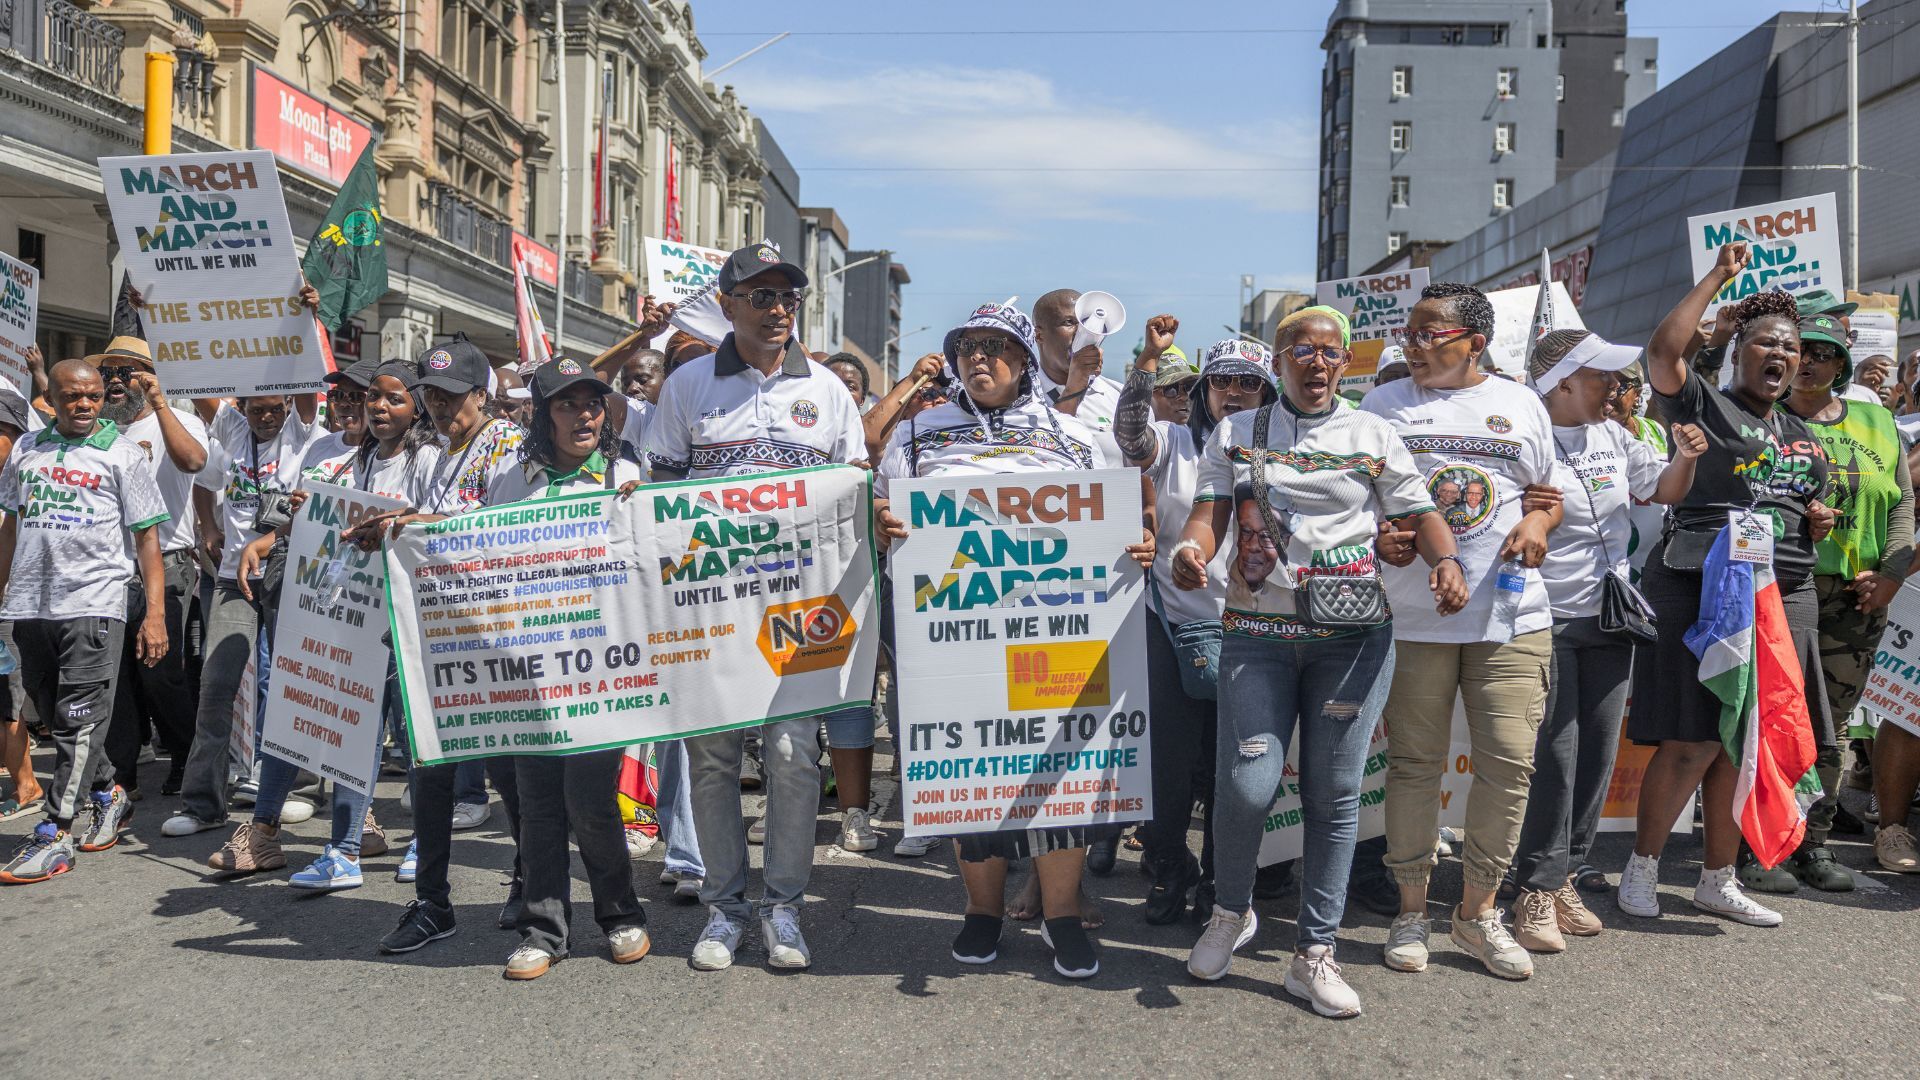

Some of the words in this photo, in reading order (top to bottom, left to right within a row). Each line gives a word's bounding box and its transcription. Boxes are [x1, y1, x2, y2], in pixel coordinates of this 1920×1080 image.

[120, 162, 259, 195] MARCH
[159, 193, 237, 222] AND
[135, 220, 272, 252] MARCH
[1703, 206, 1816, 250] MARCH
[155, 255, 198, 271] UNTIL
[202, 255, 225, 270] WE
[228, 254, 257, 268] WIN
[3, 281, 25, 301] AND
[1336, 274, 1412, 299] MARCH
[144, 302, 191, 324] THE
[198, 297, 302, 321] STREETS
[1352, 293, 1398, 313] AND
[157, 341, 202, 362] ARE
[209, 336, 304, 359] CALLING
[1374, 329, 1388, 339] WE
[797, 416, 813, 425] IFP
[1839, 437, 1885, 473] WESIZWE
[18, 466, 101, 491] MARCH
[28, 485, 78, 503] AND
[653, 480, 808, 523] MARCH
[910, 483, 1105, 529] MARCH
[24, 521, 41, 529] UNTIL
[42, 521, 53, 530] WE
[55, 523, 70, 532] WIN
[424, 501, 602, 535] #DOIT4THEIRFUTURE
[688, 514, 780, 551] AND
[1459, 528, 1484, 542] SERVICE
[1484, 520, 1494, 533] AND
[425, 520, 611, 555] #DOIT4YOURCOUNTRY
[950, 527, 1068, 569] AND
[415, 546, 606, 578] #STOPHOMEAFFAIRSCORRUPTION
[659, 539, 813, 585] MARCH
[1310, 545, 1369, 568] ALUTA
[1734, 553, 1770, 562] OBSERVER
[417, 580, 437, 594] JOIN
[439, 579, 452, 591] US
[455, 578, 465, 589] IN
[468, 573, 513, 588] FIGHTING
[517, 568, 558, 582] ILLEGAL
[562, 561, 626, 577] IMMIGRANTS
[420, 595, 438, 608] AND
[440, 591, 468, 605] THEIR
[472, 588, 509, 602] CRIMES
[513, 573, 628, 597] #ENOUGHISENOUGH
[675, 586, 728, 607] UNTIL
[733, 580, 761, 598] WE
[768, 574, 801, 593] WIN
[914, 565, 1107, 612] MARCH
[328, 604, 344, 622] WE
[345, 609, 366, 628] WIN
[422, 609, 445, 622] STOP
[447, 606, 484, 619] ILLEGAL
[557, 594, 593, 607] START
[425, 624, 452, 638] LEGAL
[455, 621, 515, 635] IMMIGRATION
[522, 608, 601, 628] #ABAHAMBE
[430, 638, 490, 654] SEKWANELE
[494, 631, 564, 649] ABAGODUKE
[570, 625, 607, 640] ABONI
[648, 626, 705, 645] RECLAIM
[710, 623, 735, 637] OUR
[928, 618, 997, 643] UNTIL
[1004, 616, 1039, 639] WE
[1048, 613, 1090, 636] WIN
[1235, 617, 1270, 632] LONG
[1273, 620, 1308, 634] LIVE
[301, 636, 328, 657] AWAY
[329, 643, 353, 666] WITH
[434, 660, 477, 688] IT'S
[484, 653, 545, 683] TIME
[555, 648, 593, 676] TO
[605, 642, 641, 669] GO
[650, 648, 710, 666] COUNTRY
[801, 645, 845, 657] IMMIGRATION
[276, 655, 304, 679] CRIME,
[306, 665, 337, 691] DRUGS,
[339, 677, 375, 703] ILLEGAL
[1013, 650, 1049, 684] NO
[1051, 671, 1087, 684] ILLEGAL
[434, 692, 486, 710] ILLEGAL
[489, 683, 573, 704] IMMIGRATION
[578, 681, 592, 695] IS
[597, 679, 609, 693] A
[613, 672, 659, 691] CRIME
[1035, 682, 1105, 697] IMMIGRATION
[1870, 672, 1888, 688] US
[1888, 682, 1904, 697] IN
[283, 685, 339, 719] IMMIGRATION
[341, 708, 360, 726] AND
[437, 714, 465, 729] LAW
[470, 706, 561, 726] ENFORCEMENT
[566, 702, 600, 718] WHO
[604, 695, 654, 711] TAKES
[659, 692, 671, 705] A
[294, 716, 343, 749] EXTORTION
[441, 737, 480, 752] BRIBE
[485, 734, 496, 747] IS
[501, 733, 510, 746] A
[513, 729, 573, 746] CRIMINAL
[910, 721, 963, 751] IT'S
[974, 716, 1046, 748] TIME
[1058, 712, 1097, 742] TO
[1109, 709, 1147, 739] GO
[906, 747, 1138, 782] #DOIT4THEIRFUTURE
[912, 789, 945, 805] JOIN
[950, 788, 969, 802] US
[974, 786, 988, 801] IN
[993, 782, 1057, 799] FIGHTING
[1063, 778, 1121, 795] ILLEGAL
[913, 806, 1003, 826] IMMIGRANTS
[1008, 803, 1038, 820] AND
[1043, 800, 1086, 817] THEIR
[1090, 797, 1144, 814] CRIMES
